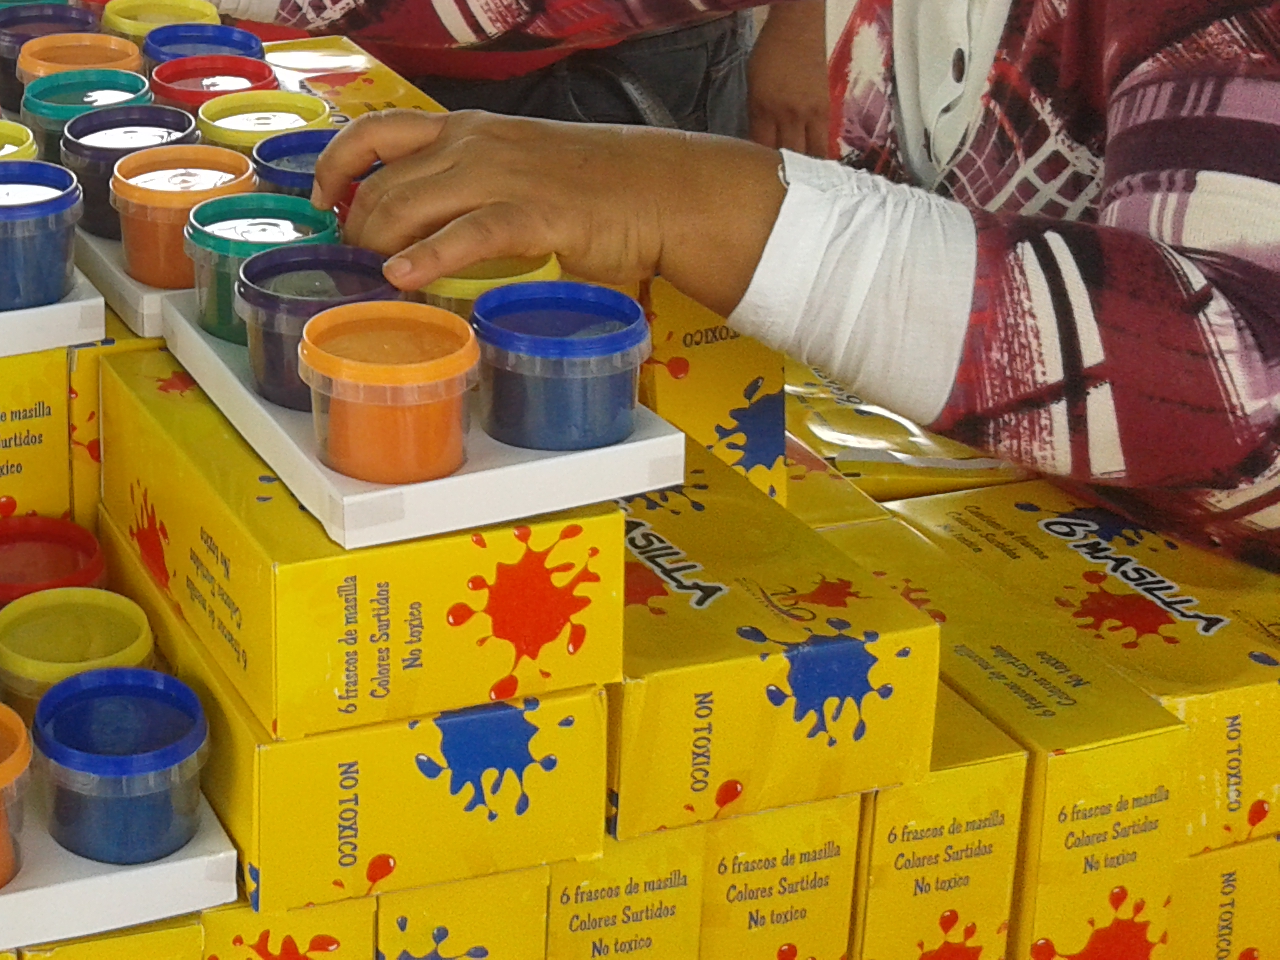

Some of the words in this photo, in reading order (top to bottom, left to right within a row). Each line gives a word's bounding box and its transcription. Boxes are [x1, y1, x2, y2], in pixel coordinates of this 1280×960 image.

[10, 401, 52, 421] masilla
[1039, 518, 1100, 540] 6
[337, 575, 358, 626] masilla
[1068, 539, 1231, 636] MASILLA
[369, 581, 391, 644] Surtidos
[404, 602, 424, 645] toxico
[338, 629, 358, 646] de
[338, 650, 358, 700] frascos
[369, 647, 391, 699] Colores
[401, 648, 423, 671] No
[338, 703, 357, 714] 6
[694, 691, 714, 719] NO
[1225, 714, 1241, 741] NO
[690, 722, 713, 793] TOXICO
[338, 760, 360, 790] NO
[1226, 743, 1242, 813] TOXICO
[1058, 806, 1067, 823] 6
[1116, 795, 1129, 812] de
[338, 793, 359, 868] TOXICO
[888, 826, 897, 844] 6
[901, 825, 945, 842] frascos
[948, 817, 962, 835] de
[965, 810, 1004, 832] masilla
[1065, 830, 1108, 850] Colores
[1112, 815, 1159, 839] Surtidos
[718, 857, 727, 875] 6
[732, 855, 777, 874] frascos
[781, 848, 795, 867] de
[799, 840, 841, 864] masilla
[894, 851, 939, 870] Colores
[943, 839, 993, 862] Surtidos
[1083, 854, 1100, 874] No
[560, 886, 570, 905] 6
[574, 884, 620, 904] frascos
[625, 877, 639, 895] de
[644, 869, 688, 893] masilla
[726, 883, 774, 903] Colores
[778, 871, 830, 896] Surtidos
[913, 877, 931, 896] No
[935, 874, 970, 892] toxico
[1220, 871, 1237, 896] NO
[569, 913, 617, 933] Colores
[621, 900, 676, 925] Surtidos
[748, 909, 766, 930] No
[770, 905, 807, 925] toxico
[1216, 897, 1235, 960] TOXICO
[591, 937, 609, 958] No
[614, 933, 652, 954] toxico
